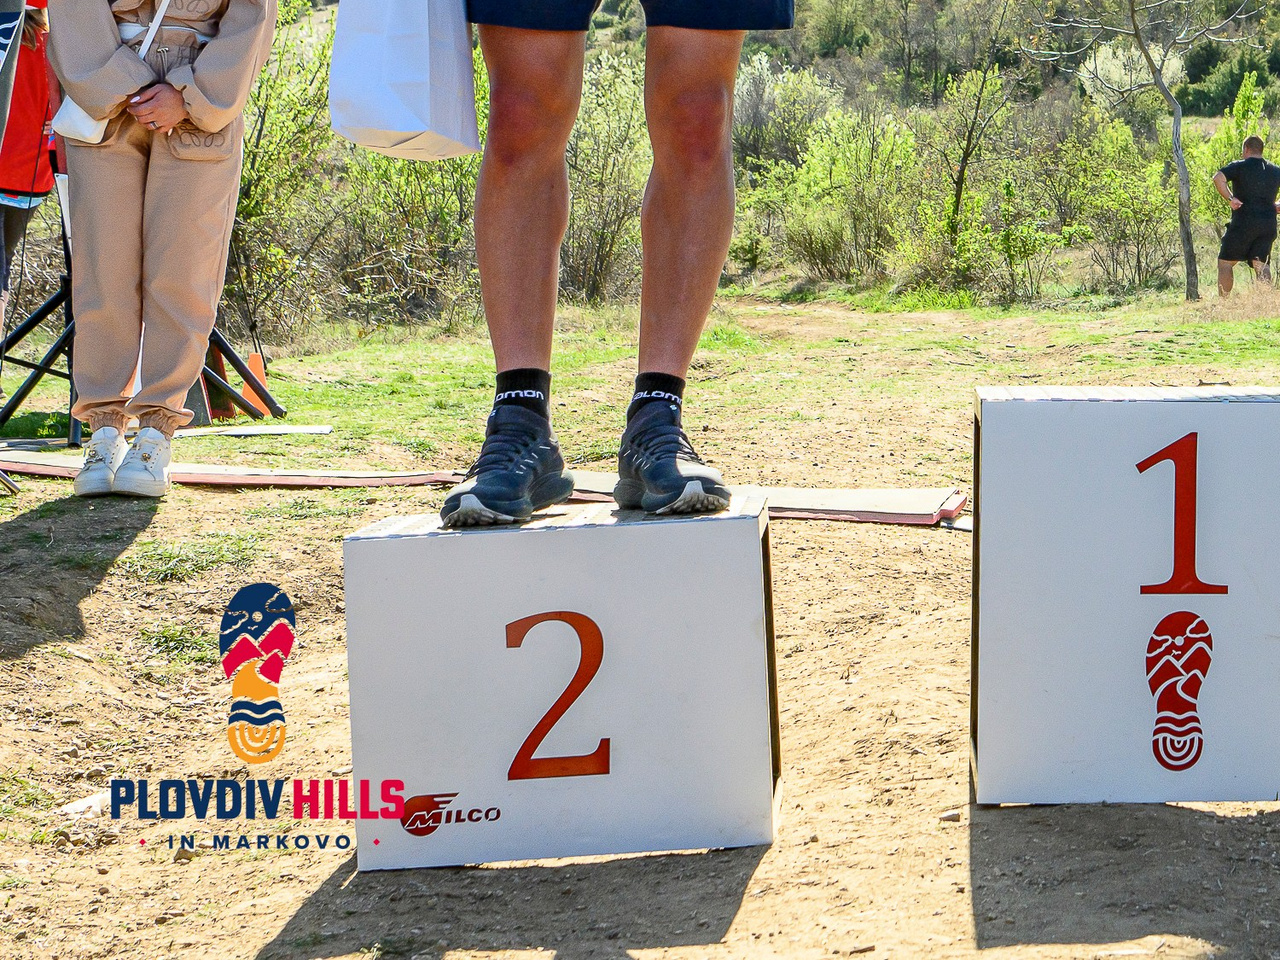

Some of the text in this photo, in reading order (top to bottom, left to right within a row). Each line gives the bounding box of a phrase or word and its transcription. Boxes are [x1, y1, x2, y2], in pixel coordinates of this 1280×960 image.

[1136, 432, 1228, 595] 1
[504, 610, 611, 781] 2
[404, 807, 501, 830] MILCO
